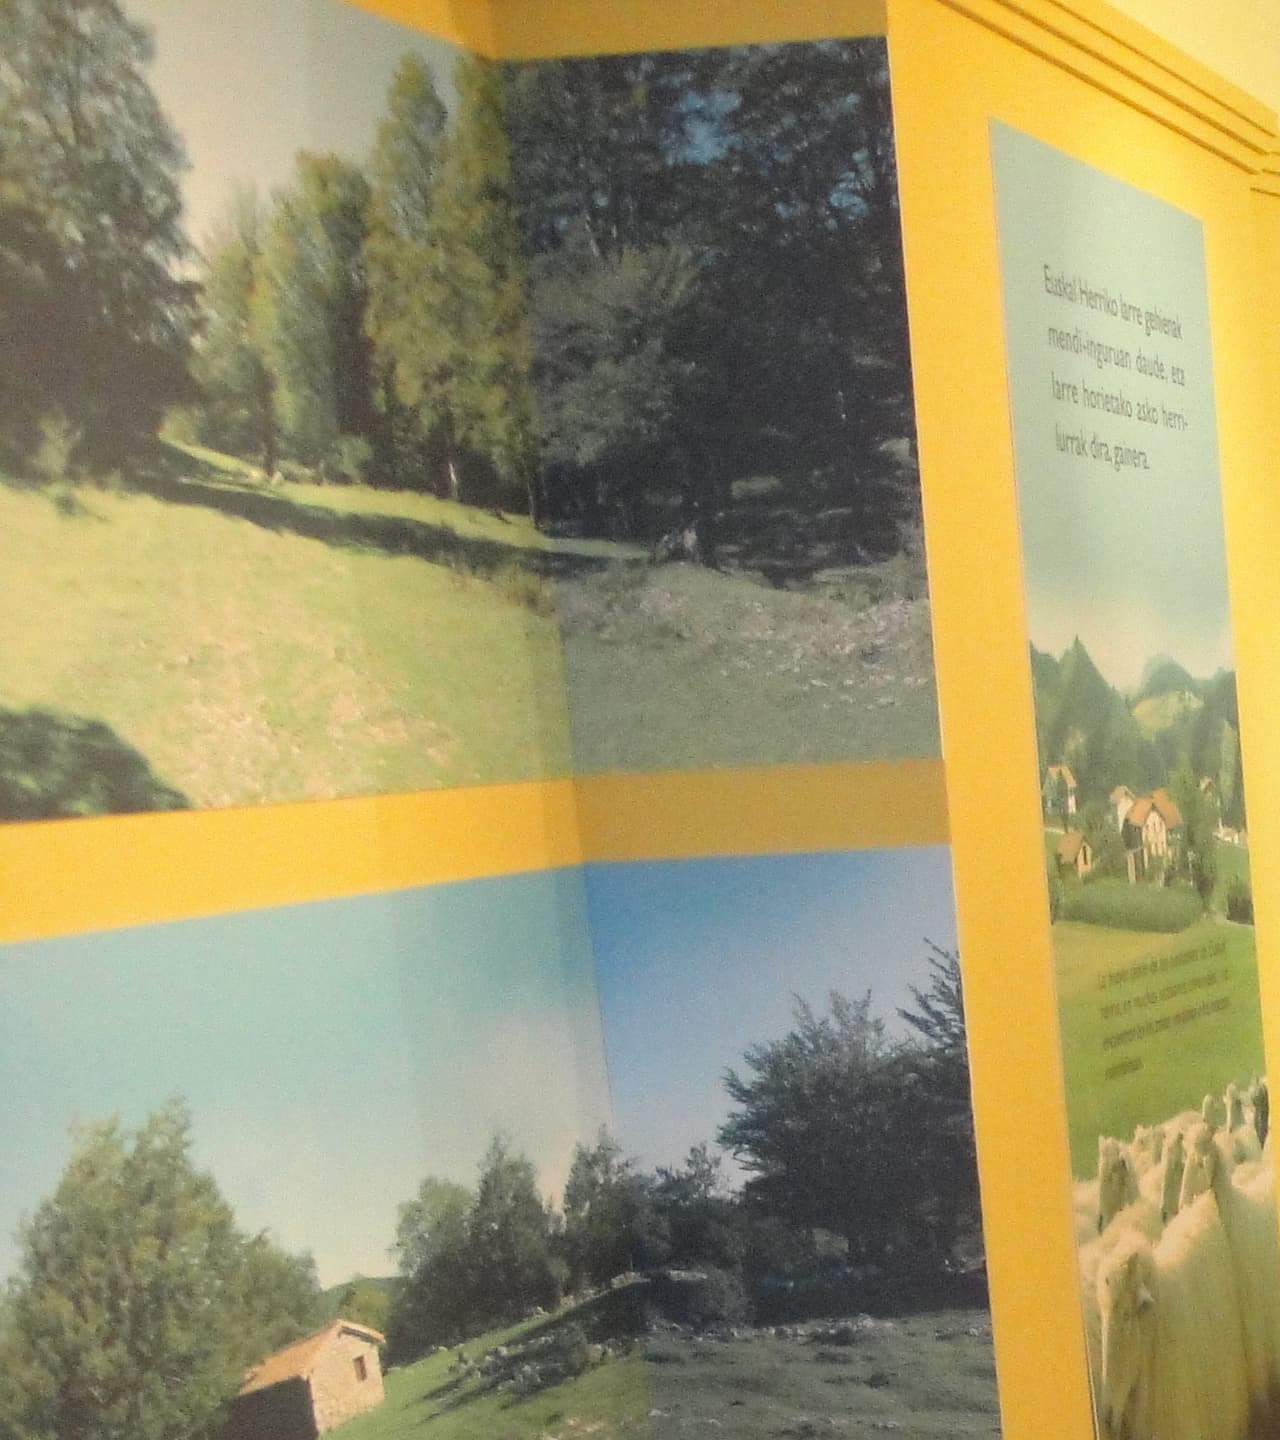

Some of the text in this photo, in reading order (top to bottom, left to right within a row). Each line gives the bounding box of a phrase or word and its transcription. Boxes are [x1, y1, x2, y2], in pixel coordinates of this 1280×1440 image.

[1043, 263, 1183, 341] Euskal Herriko larre gehienak
[1048, 326, 1185, 386] mendi-inguruan daude, eta
[1051, 370, 1189, 431] larre horietako asko herri-
[1056, 422, 1088, 458] lurrak
